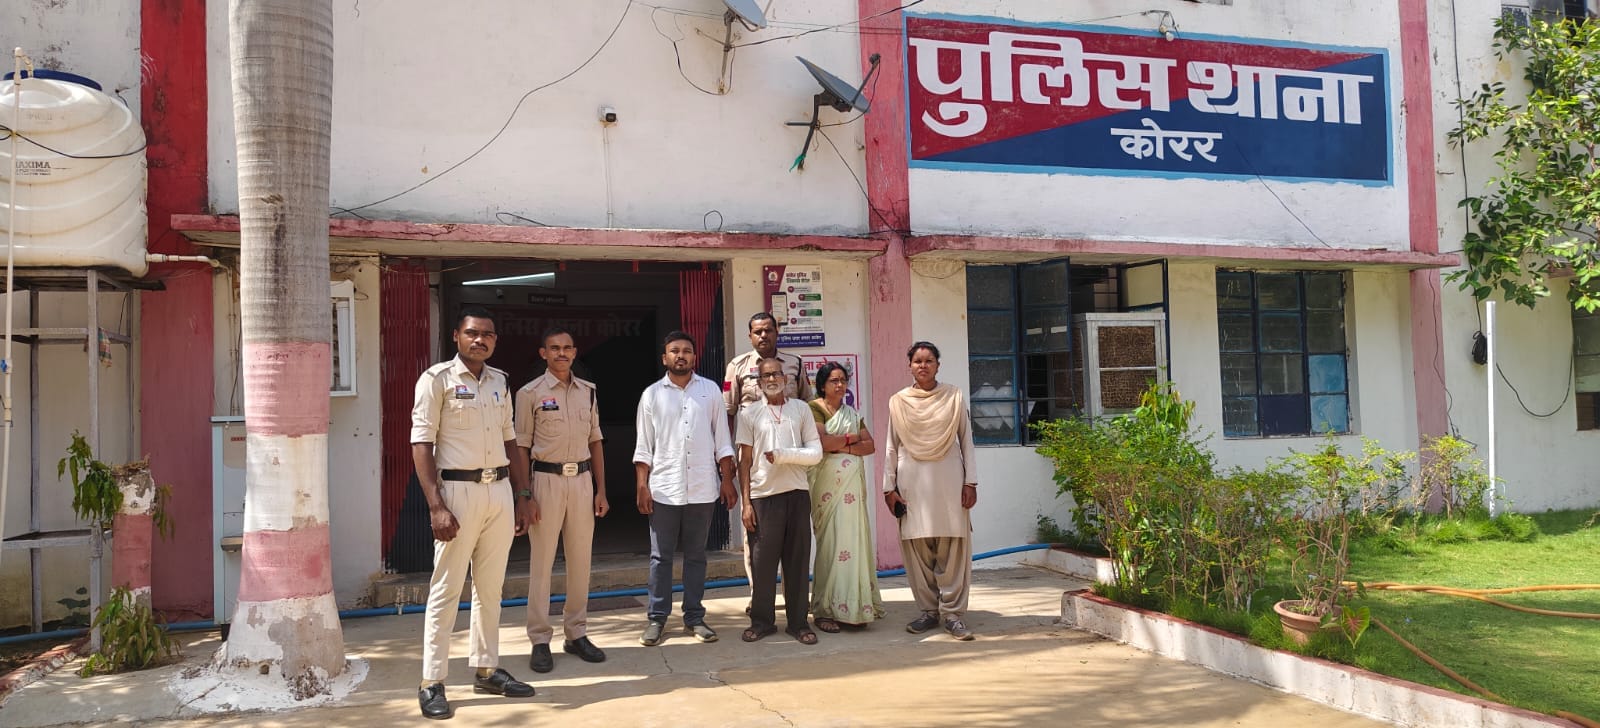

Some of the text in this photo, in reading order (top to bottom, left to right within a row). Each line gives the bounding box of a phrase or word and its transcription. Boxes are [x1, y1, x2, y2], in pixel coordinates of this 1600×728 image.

[909, 31, 1374, 138] पुलिस थाना
[1110, 118, 1223, 162] कोरर
[16, 161, 51, 169] AXIMA
[496, 312, 540, 336] लिस
